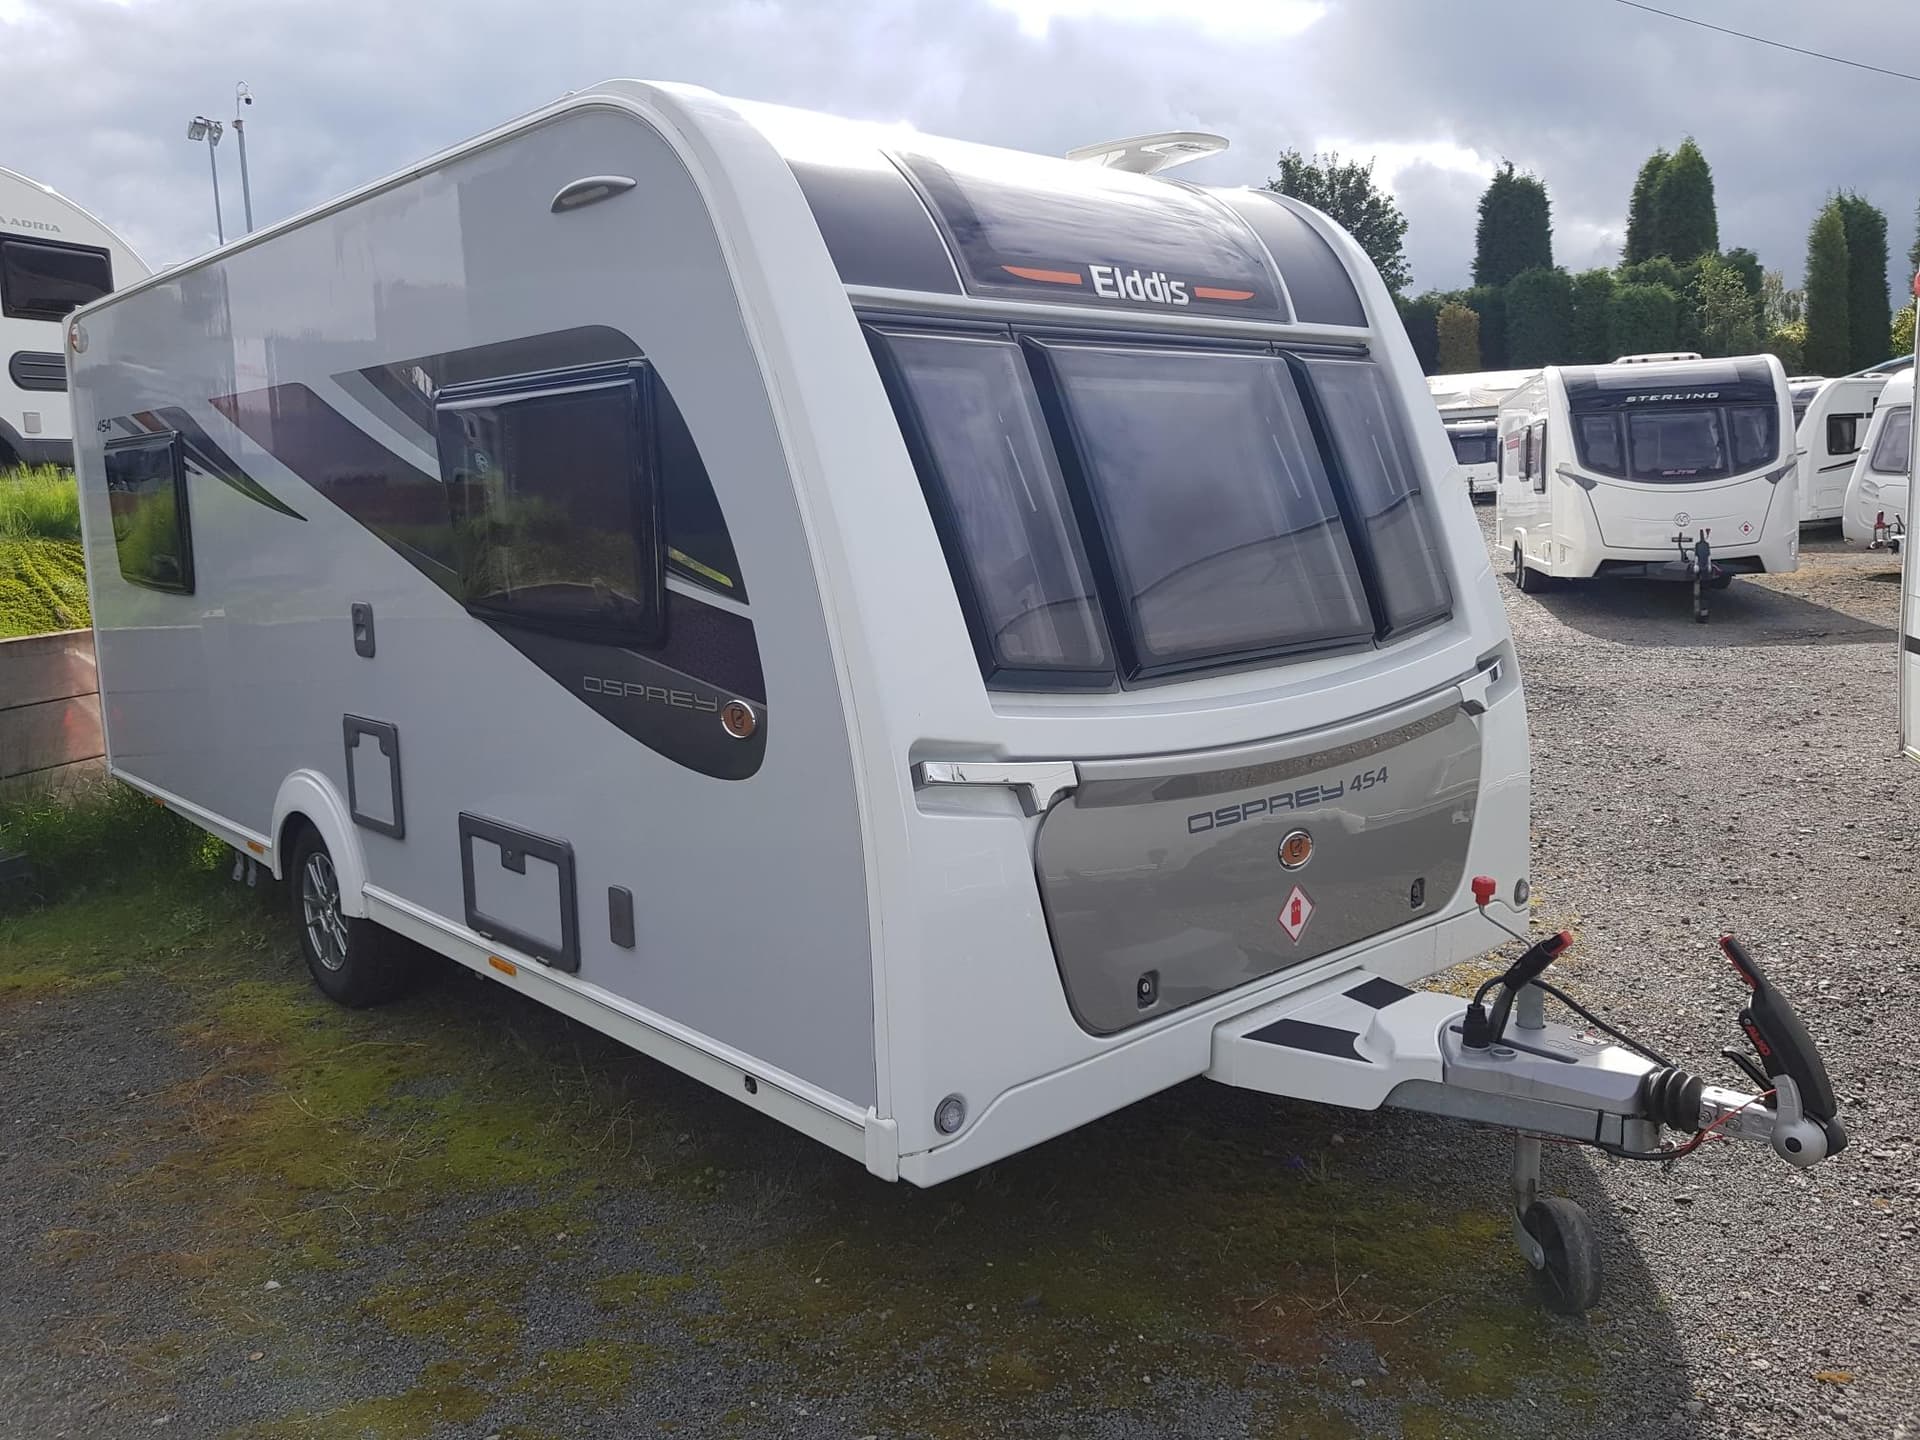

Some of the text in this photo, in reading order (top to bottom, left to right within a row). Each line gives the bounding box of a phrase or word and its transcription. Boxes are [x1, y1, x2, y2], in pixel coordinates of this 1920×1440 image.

[1088, 264, 1190, 306] Elddis
[1625, 391, 1720, 403] STERLING
[584, 675, 718, 713] OSPREY
[1187, 766, 1389, 834] OSPREY 454
